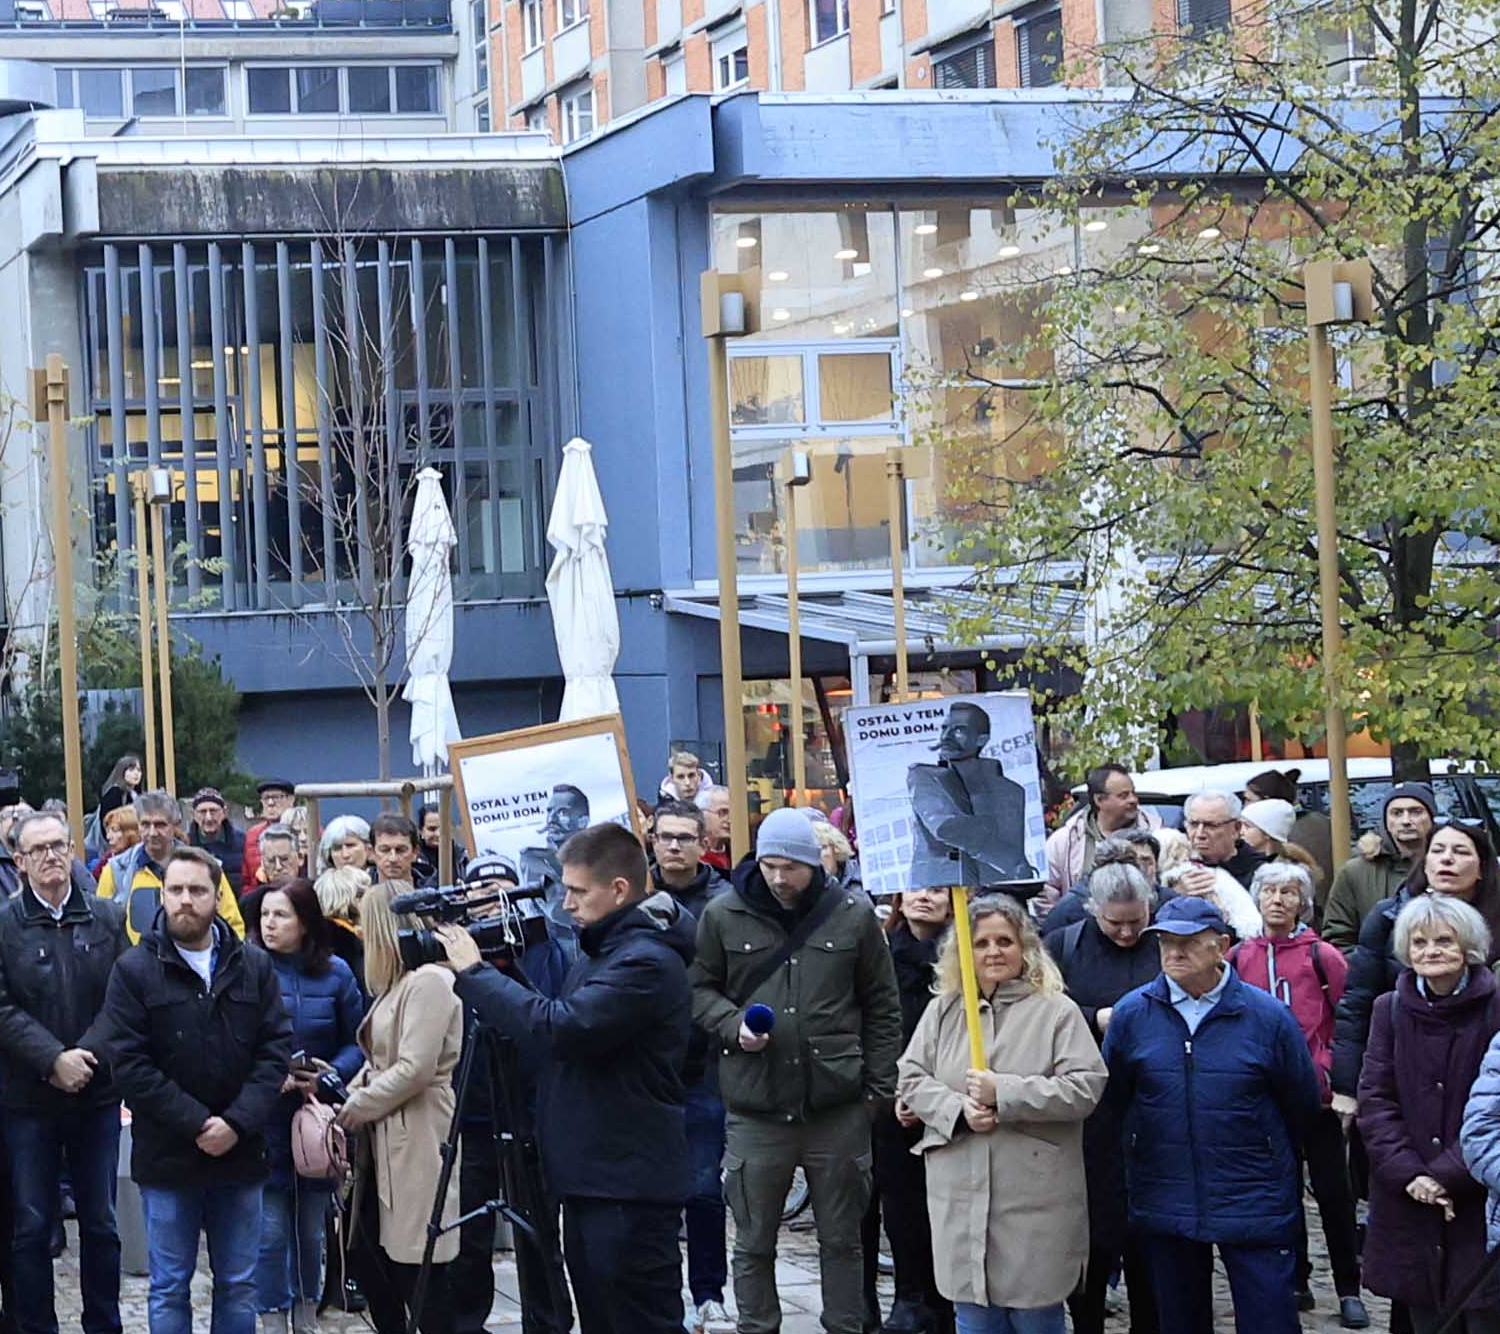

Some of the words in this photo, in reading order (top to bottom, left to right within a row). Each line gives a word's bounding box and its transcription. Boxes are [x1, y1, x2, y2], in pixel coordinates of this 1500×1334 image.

[857, 715, 899, 727] OSTAL
[903, 712, 913, 721] V
[916, 708, 945, 720] TEM
[859, 727, 900, 740] DOMU
[904, 724, 939, 736] BOM.
[471, 797, 509, 812] OSTAL
[511, 795, 520, 805] V
[523, 791, 548, 803] TEM
[473, 811, 510, 825] DOMU
[513, 806, 544, 819] BOM.
